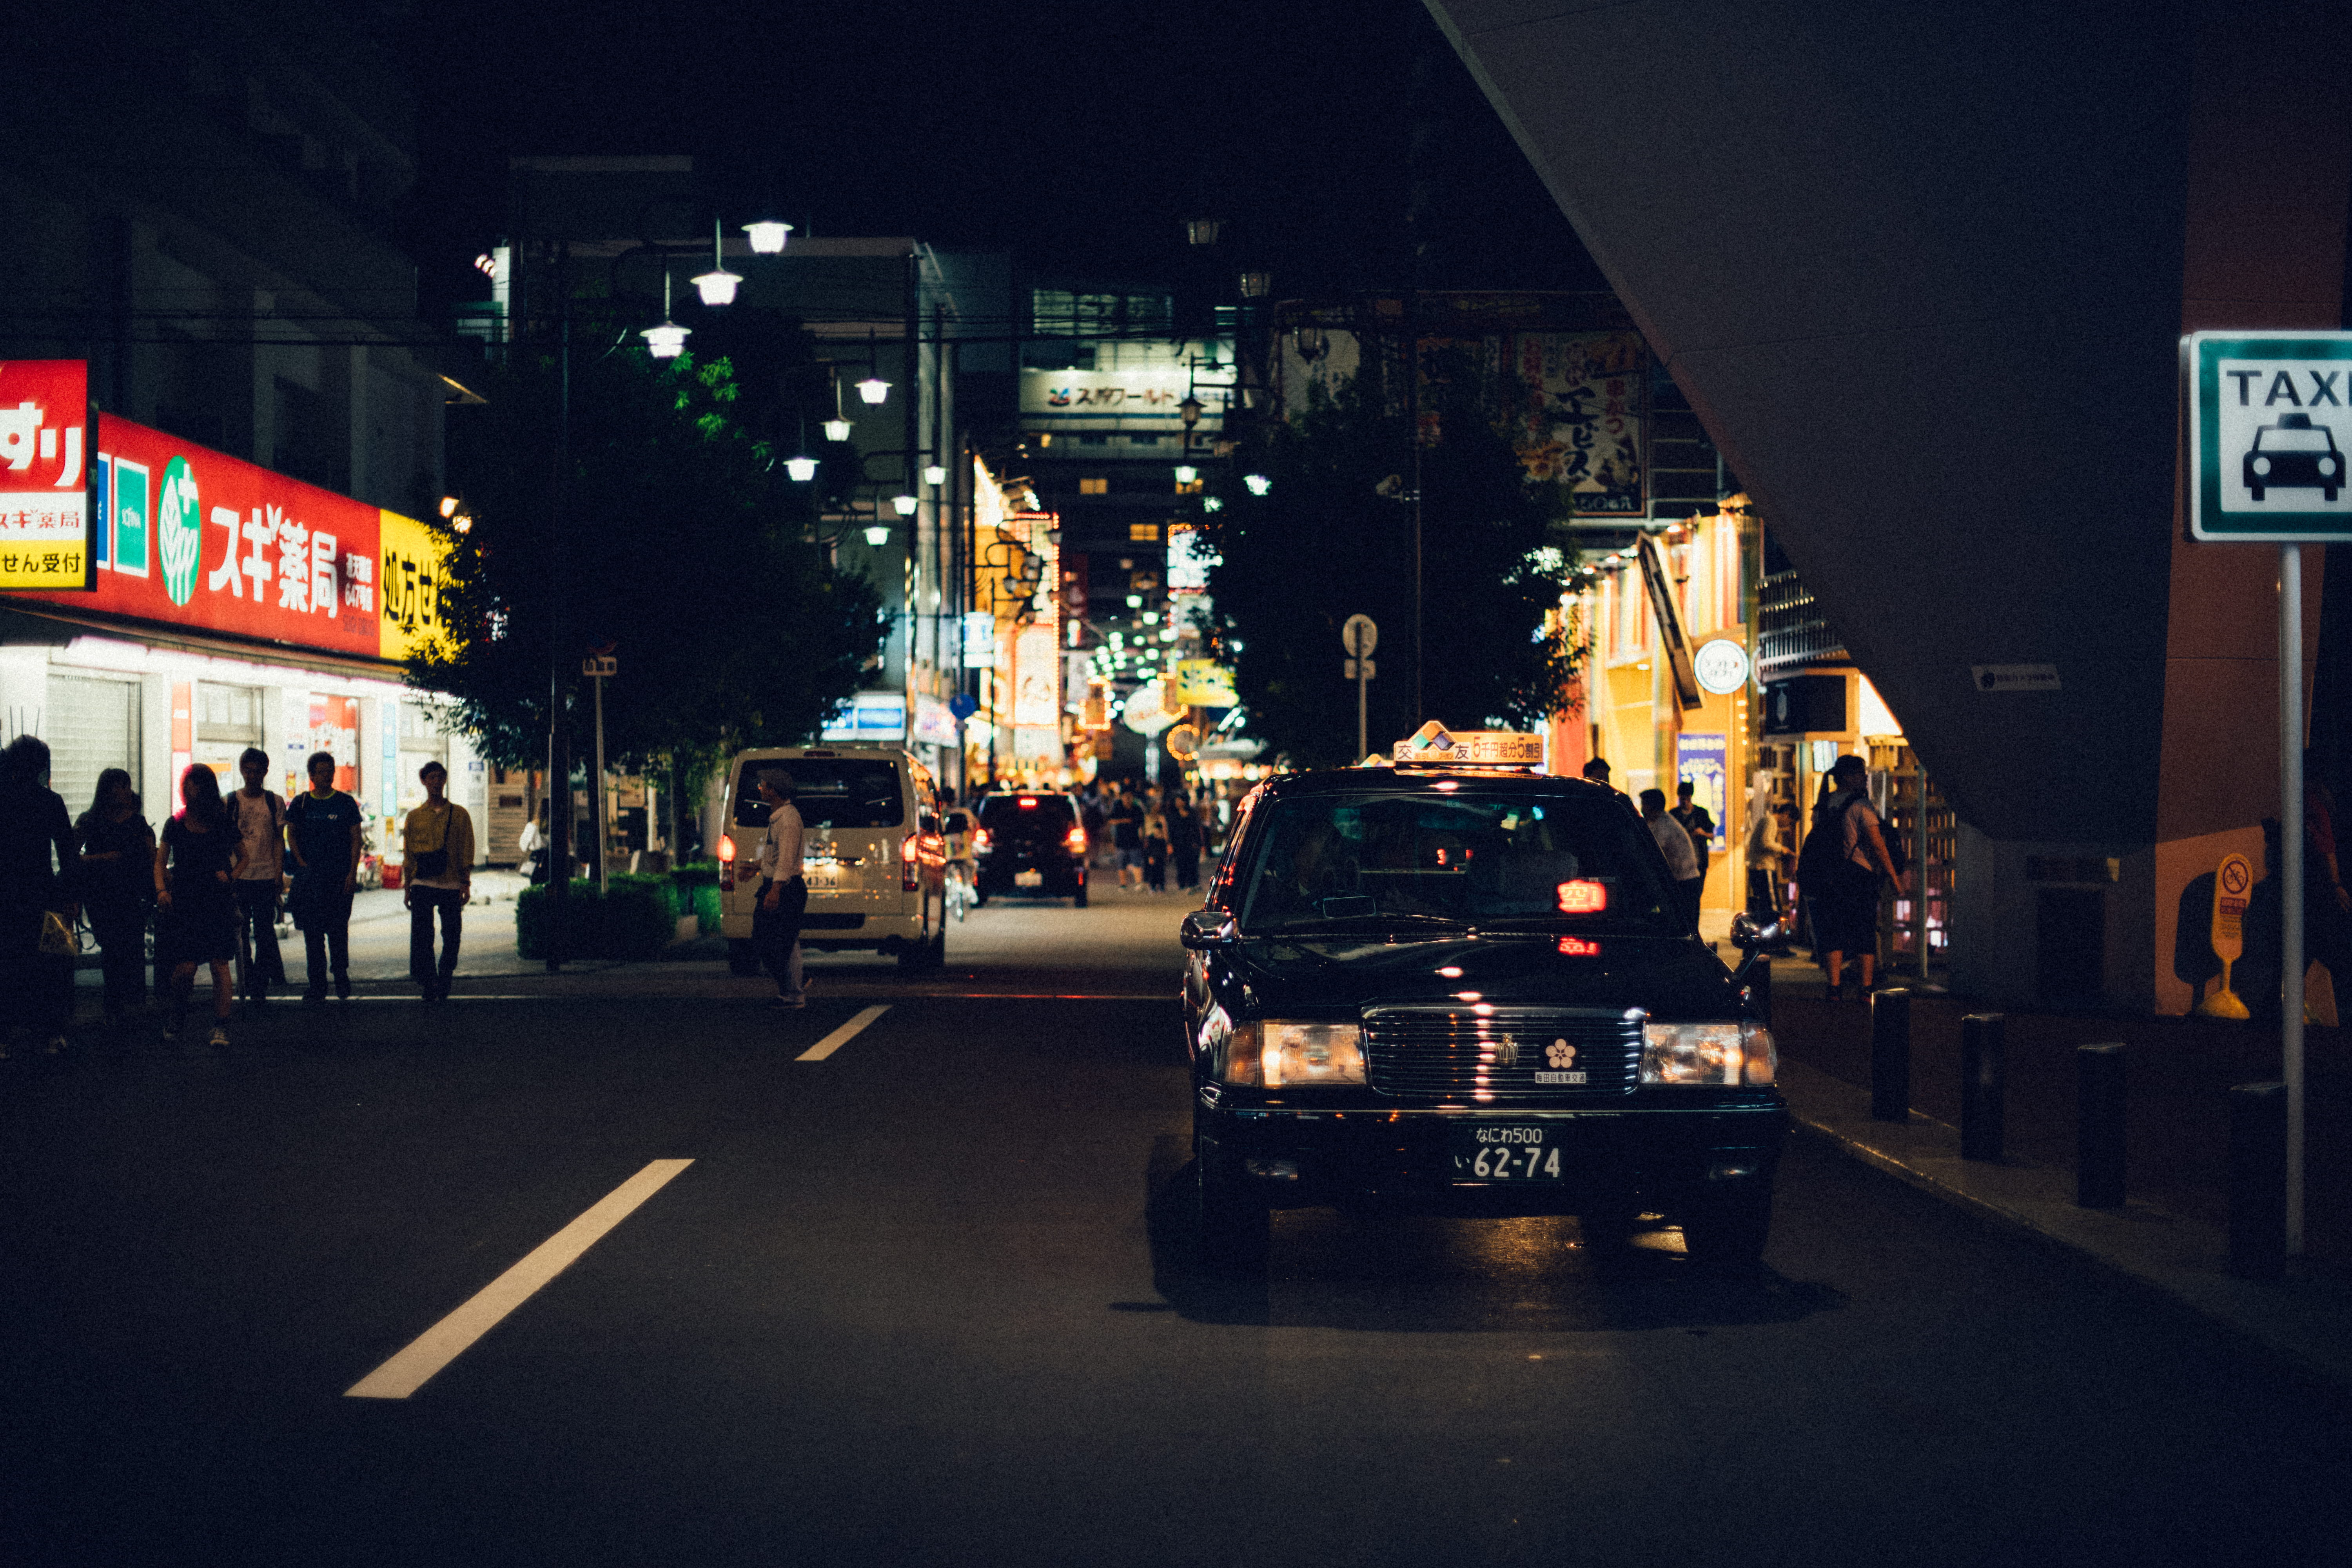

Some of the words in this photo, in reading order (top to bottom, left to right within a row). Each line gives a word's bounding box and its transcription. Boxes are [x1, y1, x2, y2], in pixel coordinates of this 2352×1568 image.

[2, 552, 80, 573] せん受付
[209, 503, 338, 619] スギ薬局
[1537, 1073, 1585, 1083] 梅田自動車交通
[1474, 1147, 1560, 1178] 62-74
